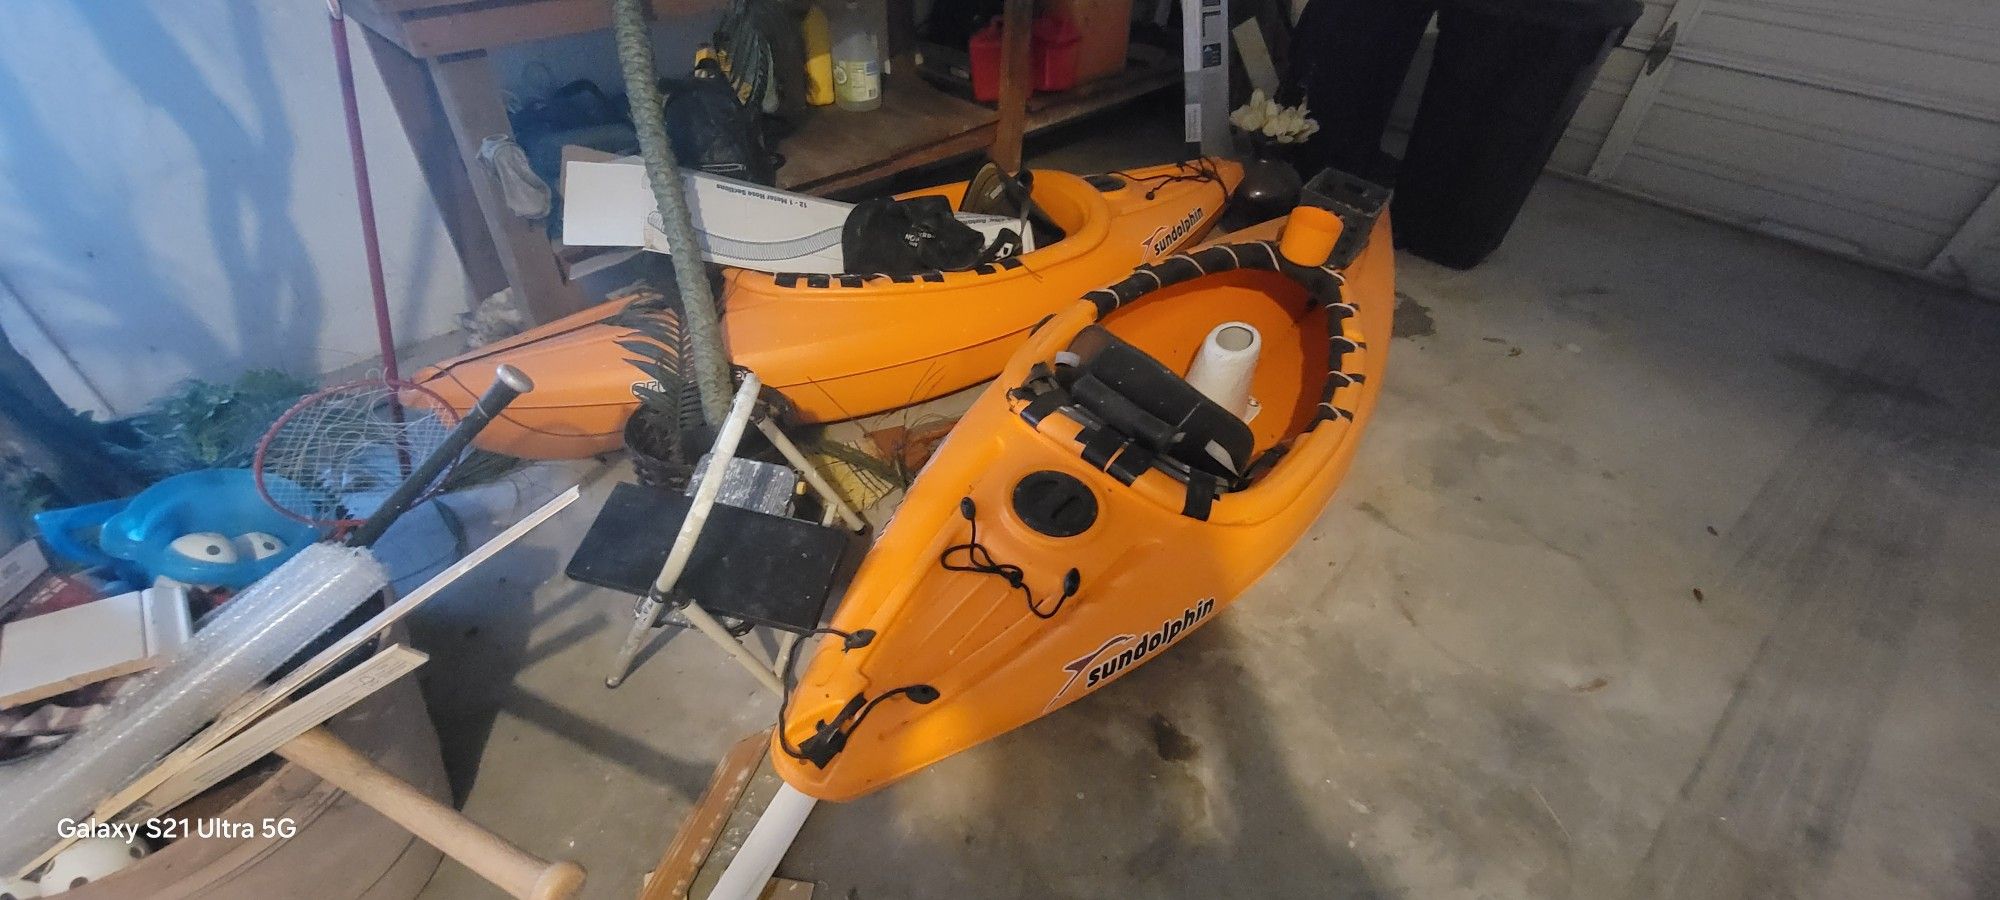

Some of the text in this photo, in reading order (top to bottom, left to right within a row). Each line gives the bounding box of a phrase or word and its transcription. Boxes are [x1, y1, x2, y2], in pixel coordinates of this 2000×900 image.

[716, 183, 746, 196] Sections
[747, 191, 765, 200] Hose
[766, 195, 788, 204] Meter
[1153, 207, 1203, 256] sundolphin
[1087, 598, 1215, 688] sundolphin
